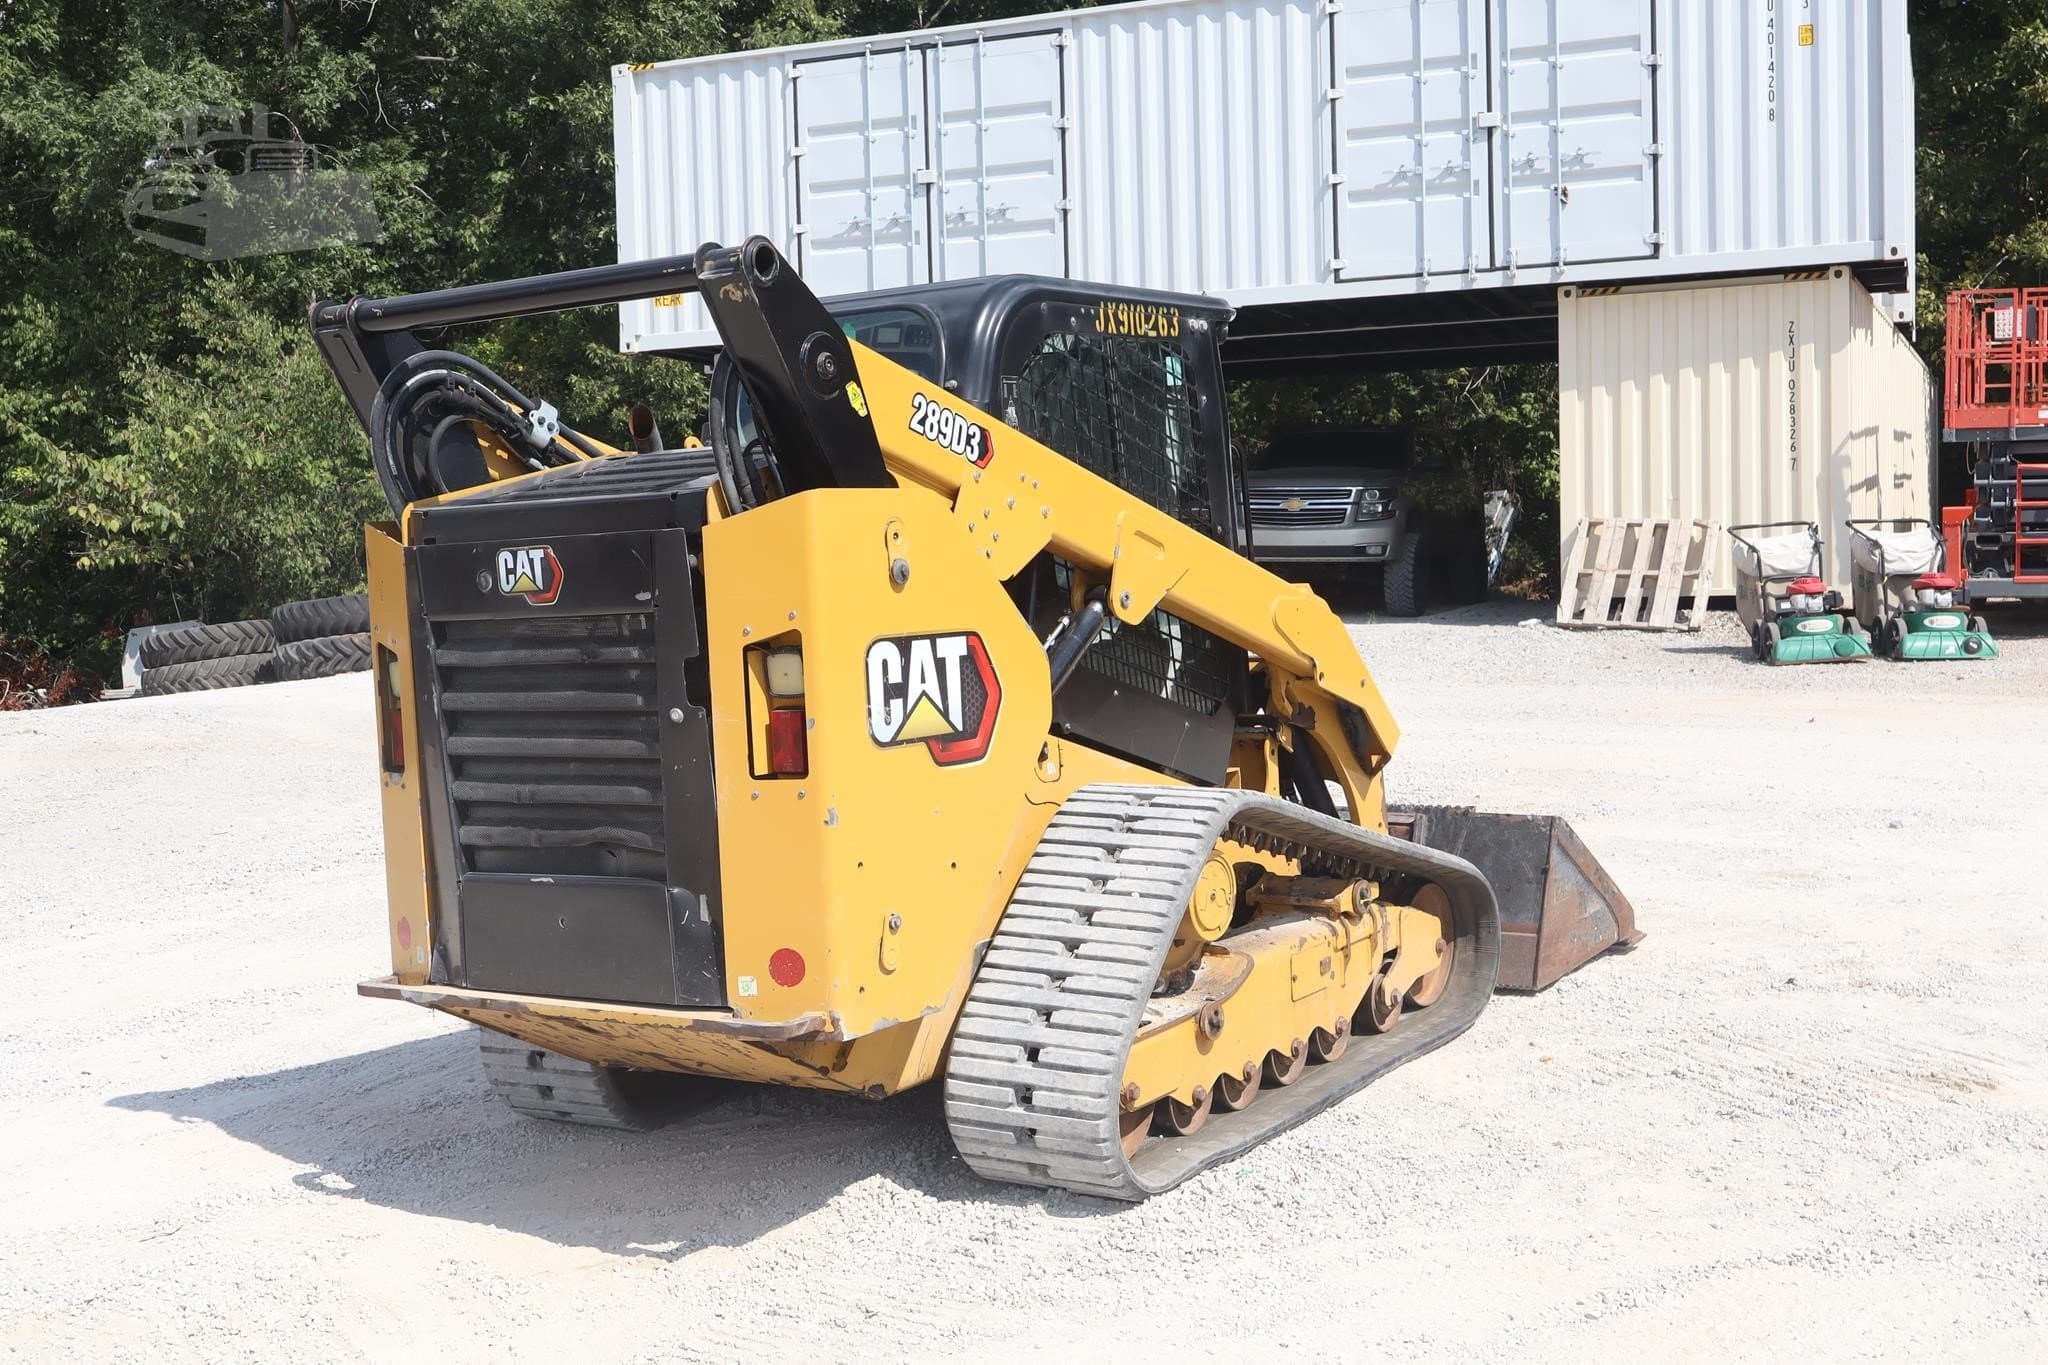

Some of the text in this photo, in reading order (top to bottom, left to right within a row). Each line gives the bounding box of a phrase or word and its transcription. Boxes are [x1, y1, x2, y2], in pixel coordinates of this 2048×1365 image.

[1095, 301, 1179, 337] JX910263
[1788, 321, 1796, 373] ZXJU
[908, 391, 982, 465] 289D3
[498, 548, 545, 593] CAT
[867, 635, 968, 743] CAT
